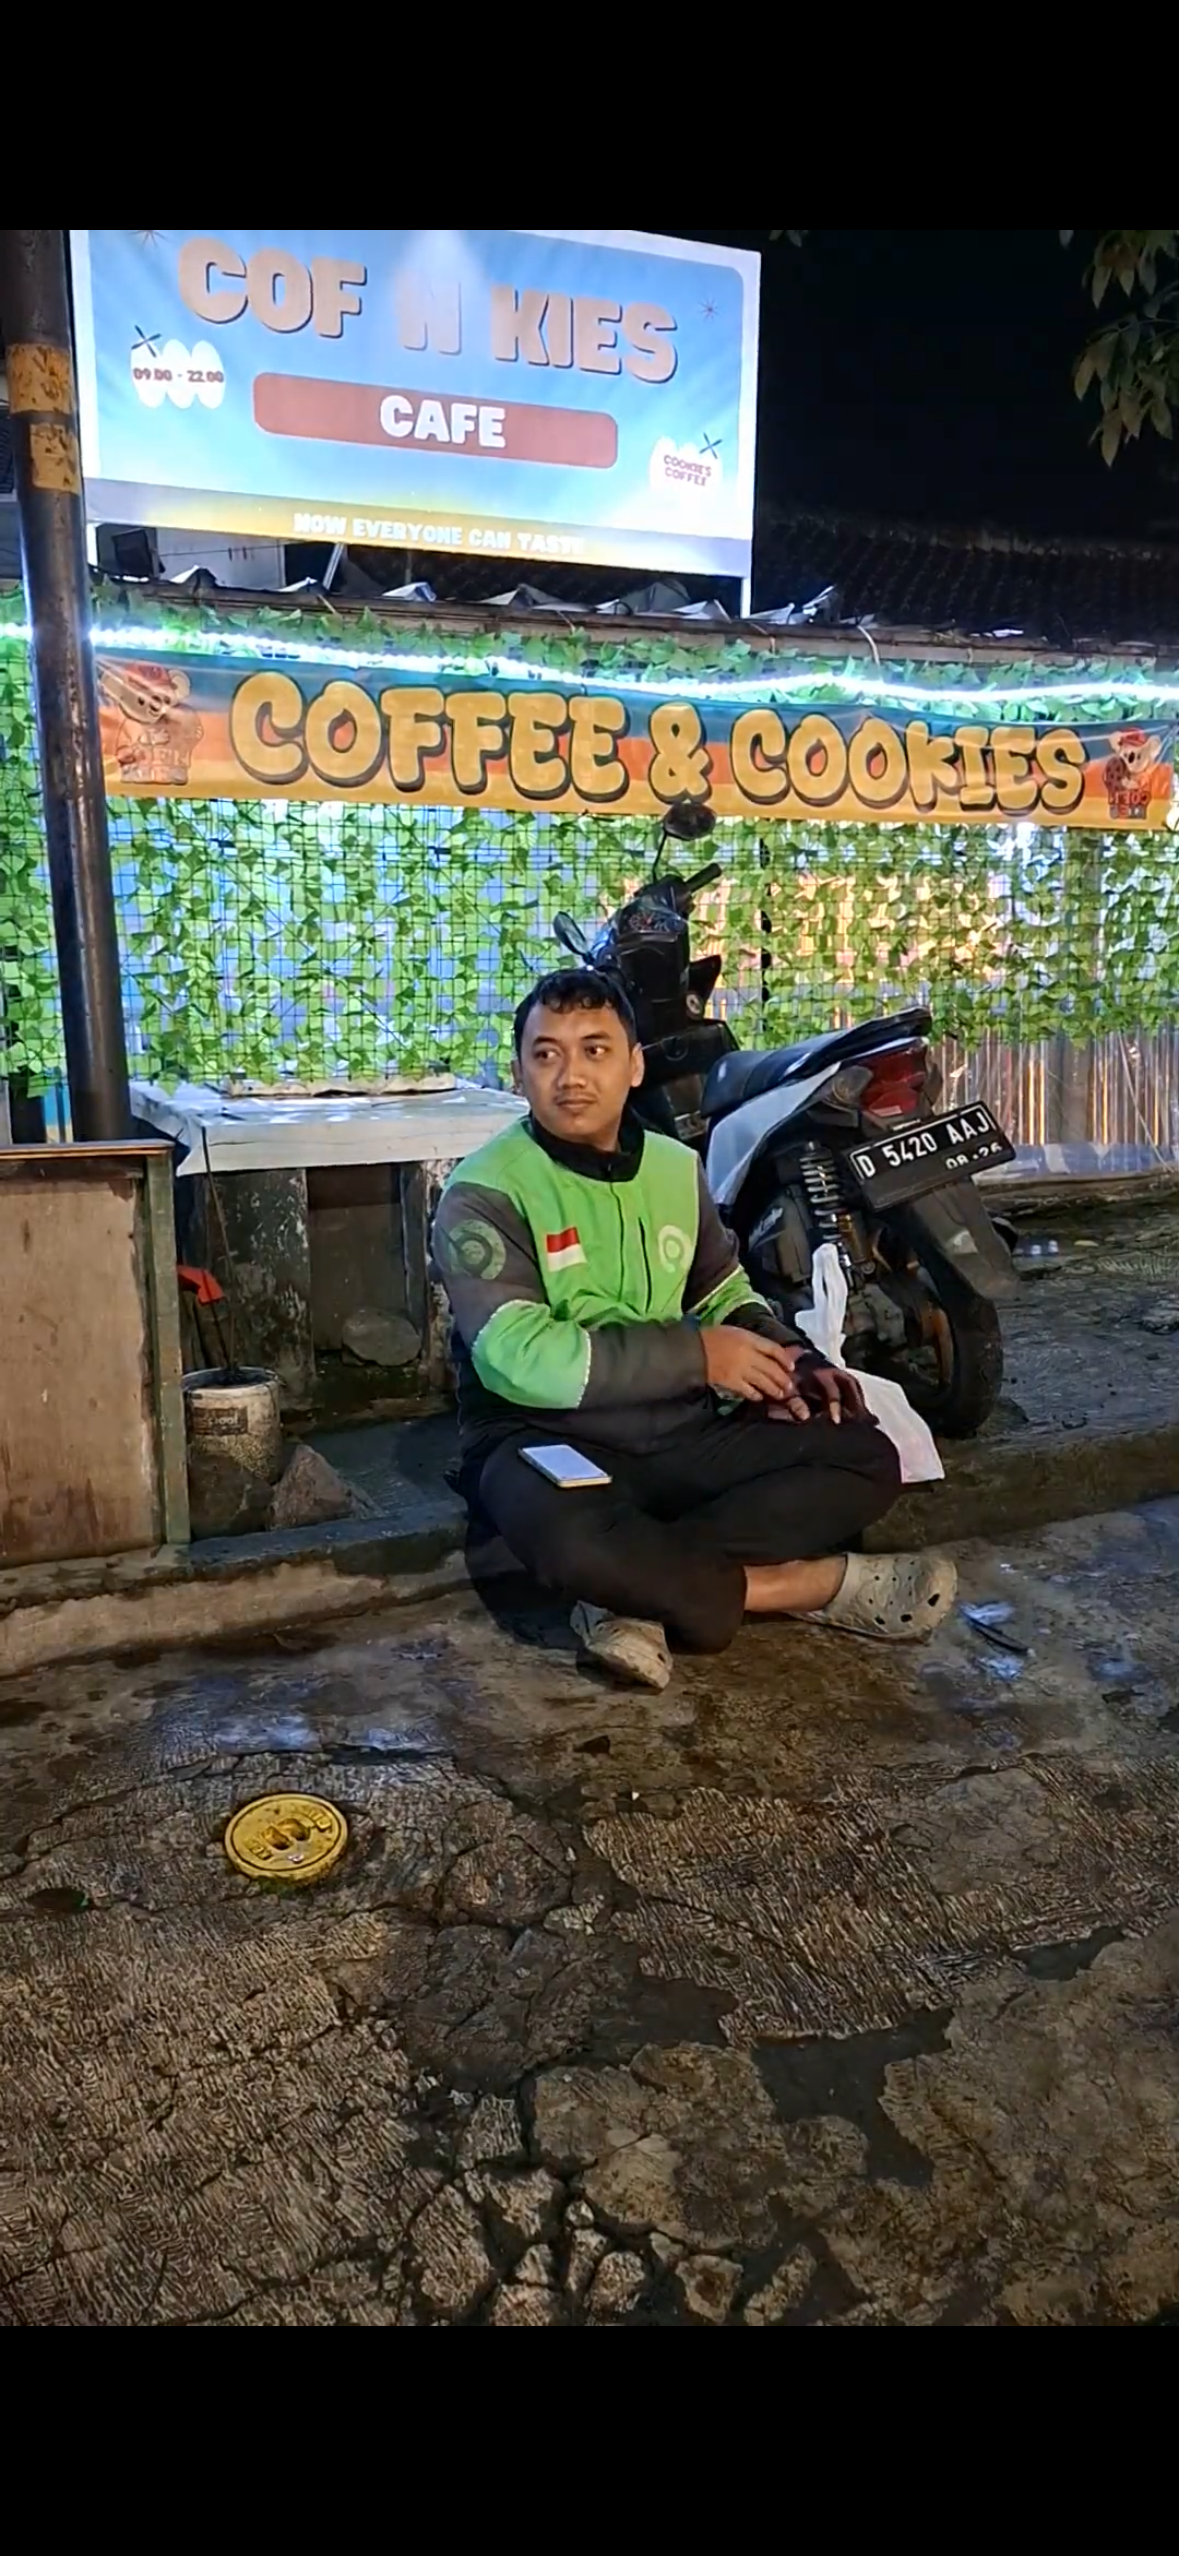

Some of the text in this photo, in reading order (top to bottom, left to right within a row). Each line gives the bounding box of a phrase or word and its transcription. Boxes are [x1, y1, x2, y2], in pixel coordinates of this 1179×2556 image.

[178, 236, 679, 384] COF N KIES
[380, 394, 506, 448] CAFE
[293, 512, 347, 536] NOW
[352, 518, 464, 546] EVERYONE
[468, 528, 512, 550] CAN
[230, 669, 1089, 815] COFFEE & COOKIES
[856, 1111, 989, 1178] D 5420 AAJ
